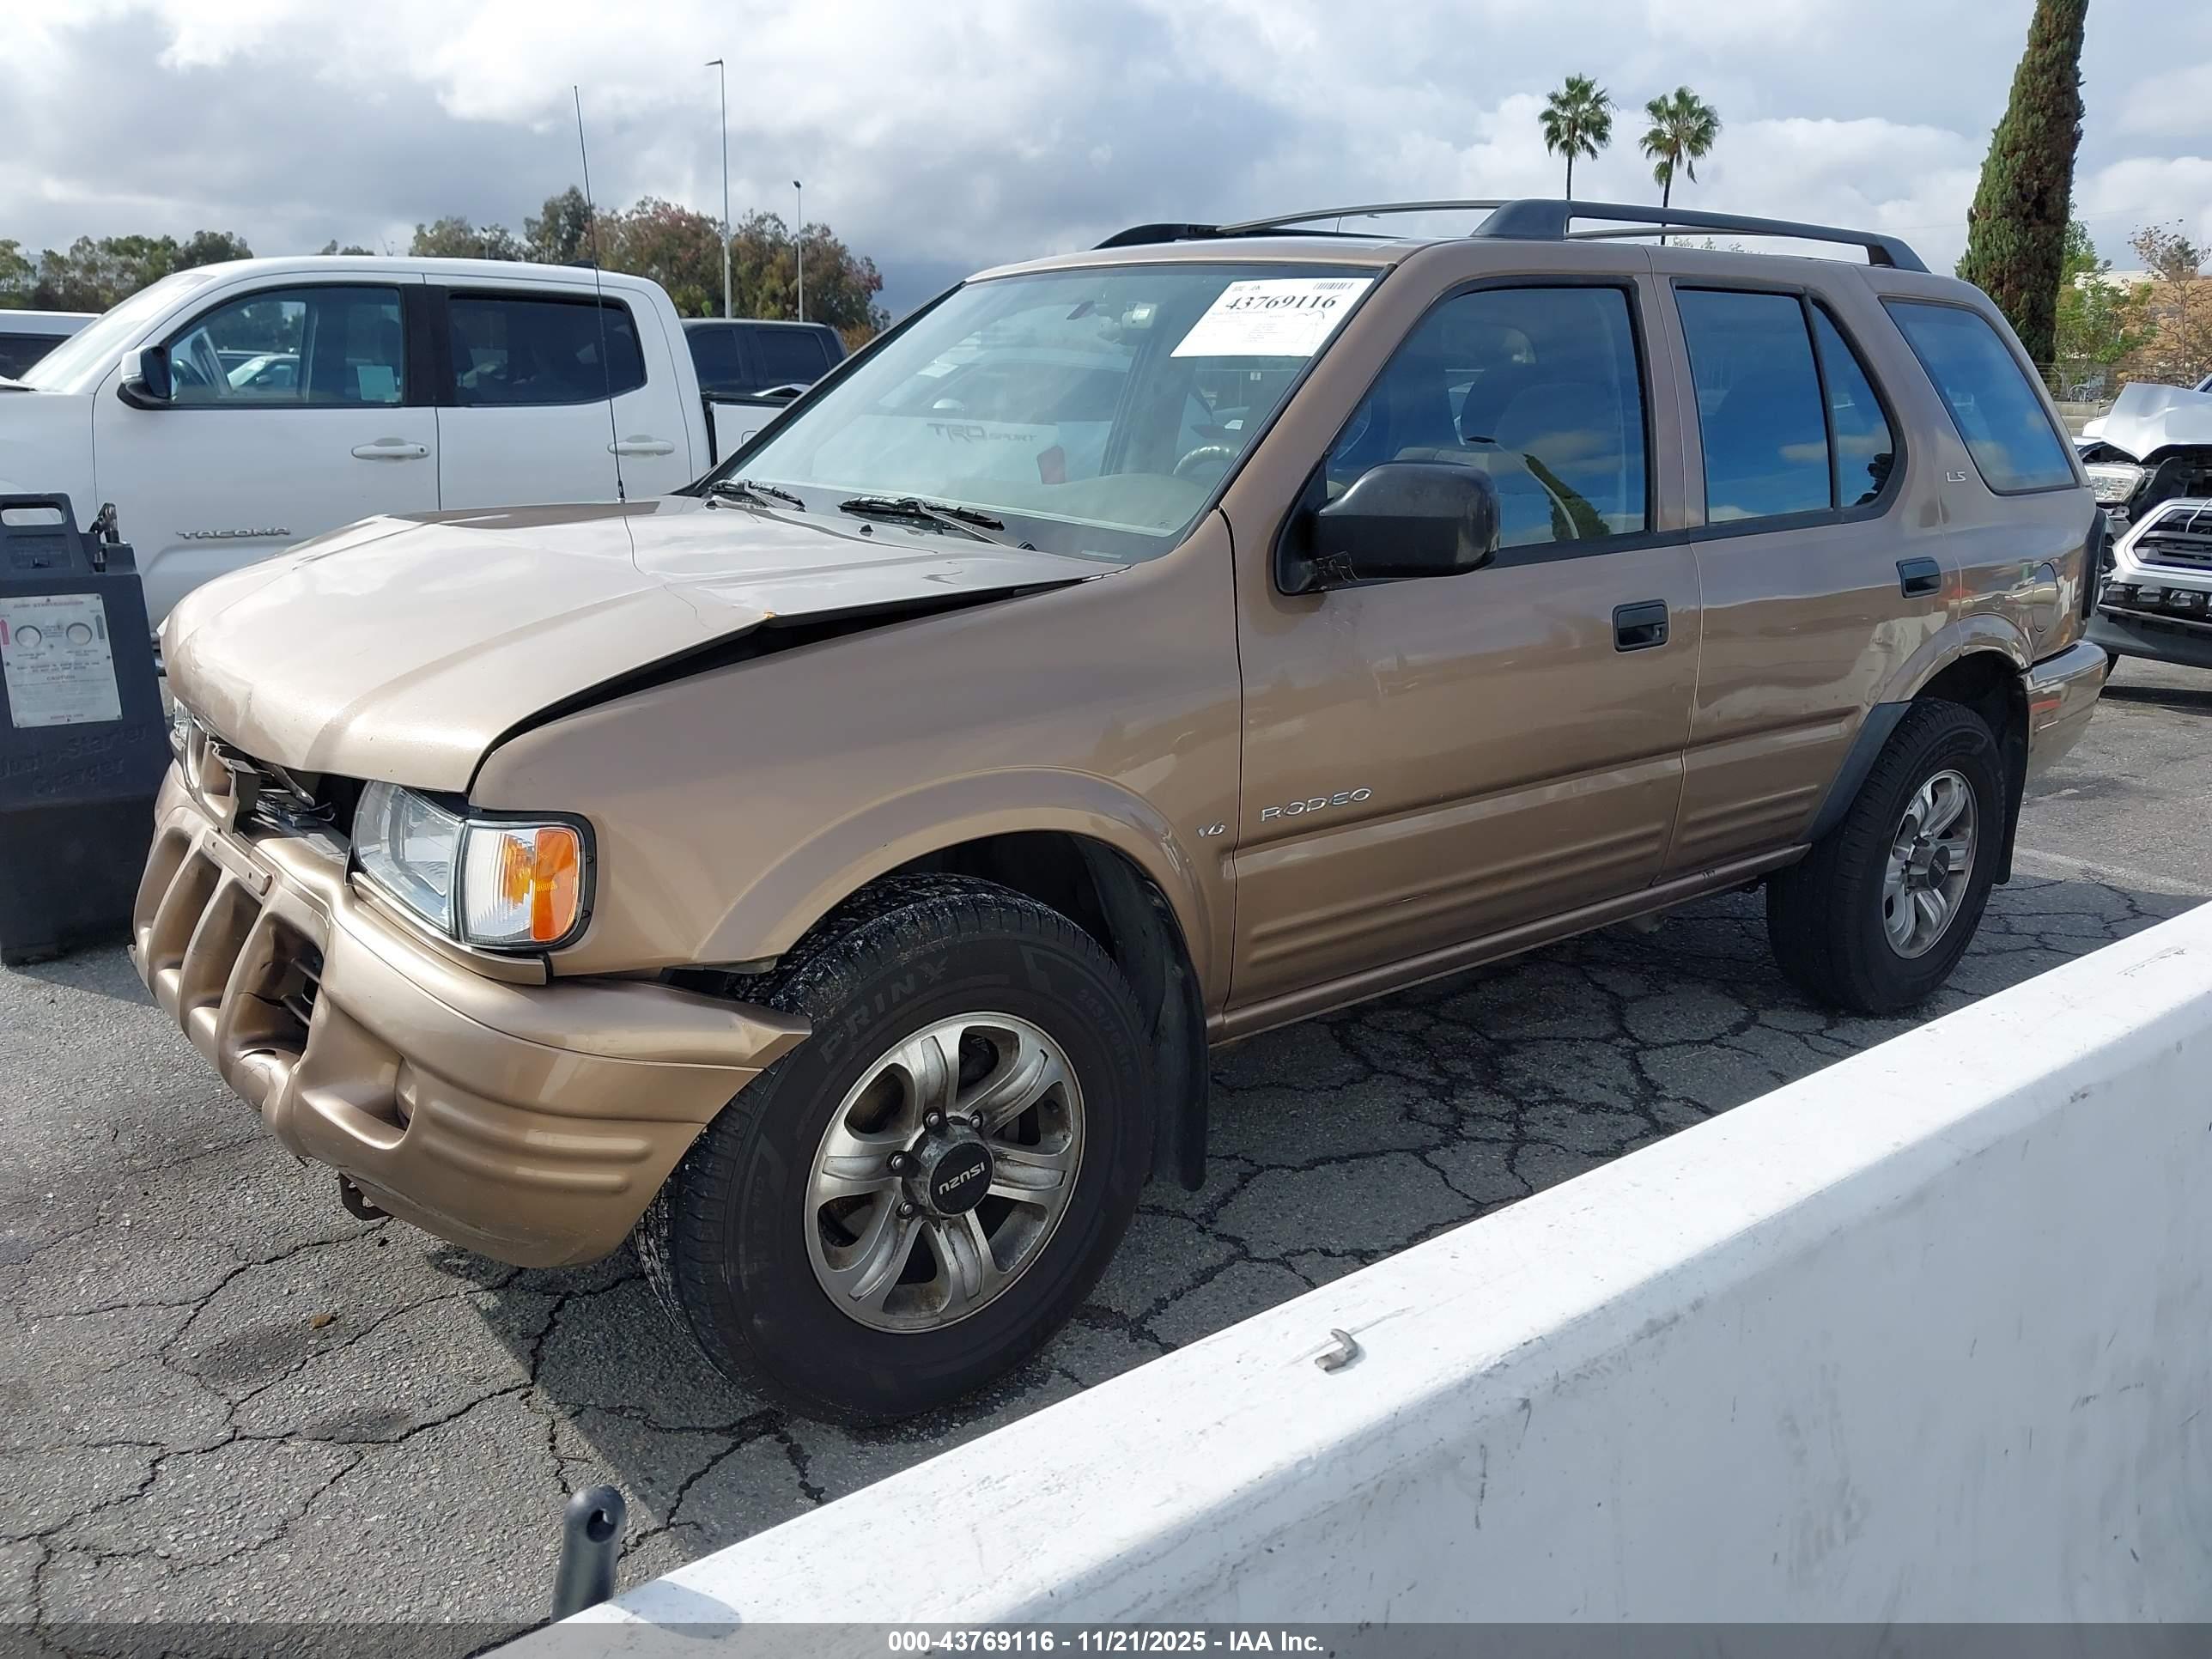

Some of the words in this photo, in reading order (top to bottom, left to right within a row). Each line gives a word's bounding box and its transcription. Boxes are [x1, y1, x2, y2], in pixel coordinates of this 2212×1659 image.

[1225, 294, 1341, 312] 43769116
[927, 422, 985, 444] TRD
[1946, 471, 1966, 483] LS
[176, 527, 291, 539] TACOMA
[1261, 787, 1372, 822] RODEO
[1197, 820, 1226, 838] V6
[820, 954, 949, 1065] PRINX
[939, 1161, 986, 1196] ISUZU
